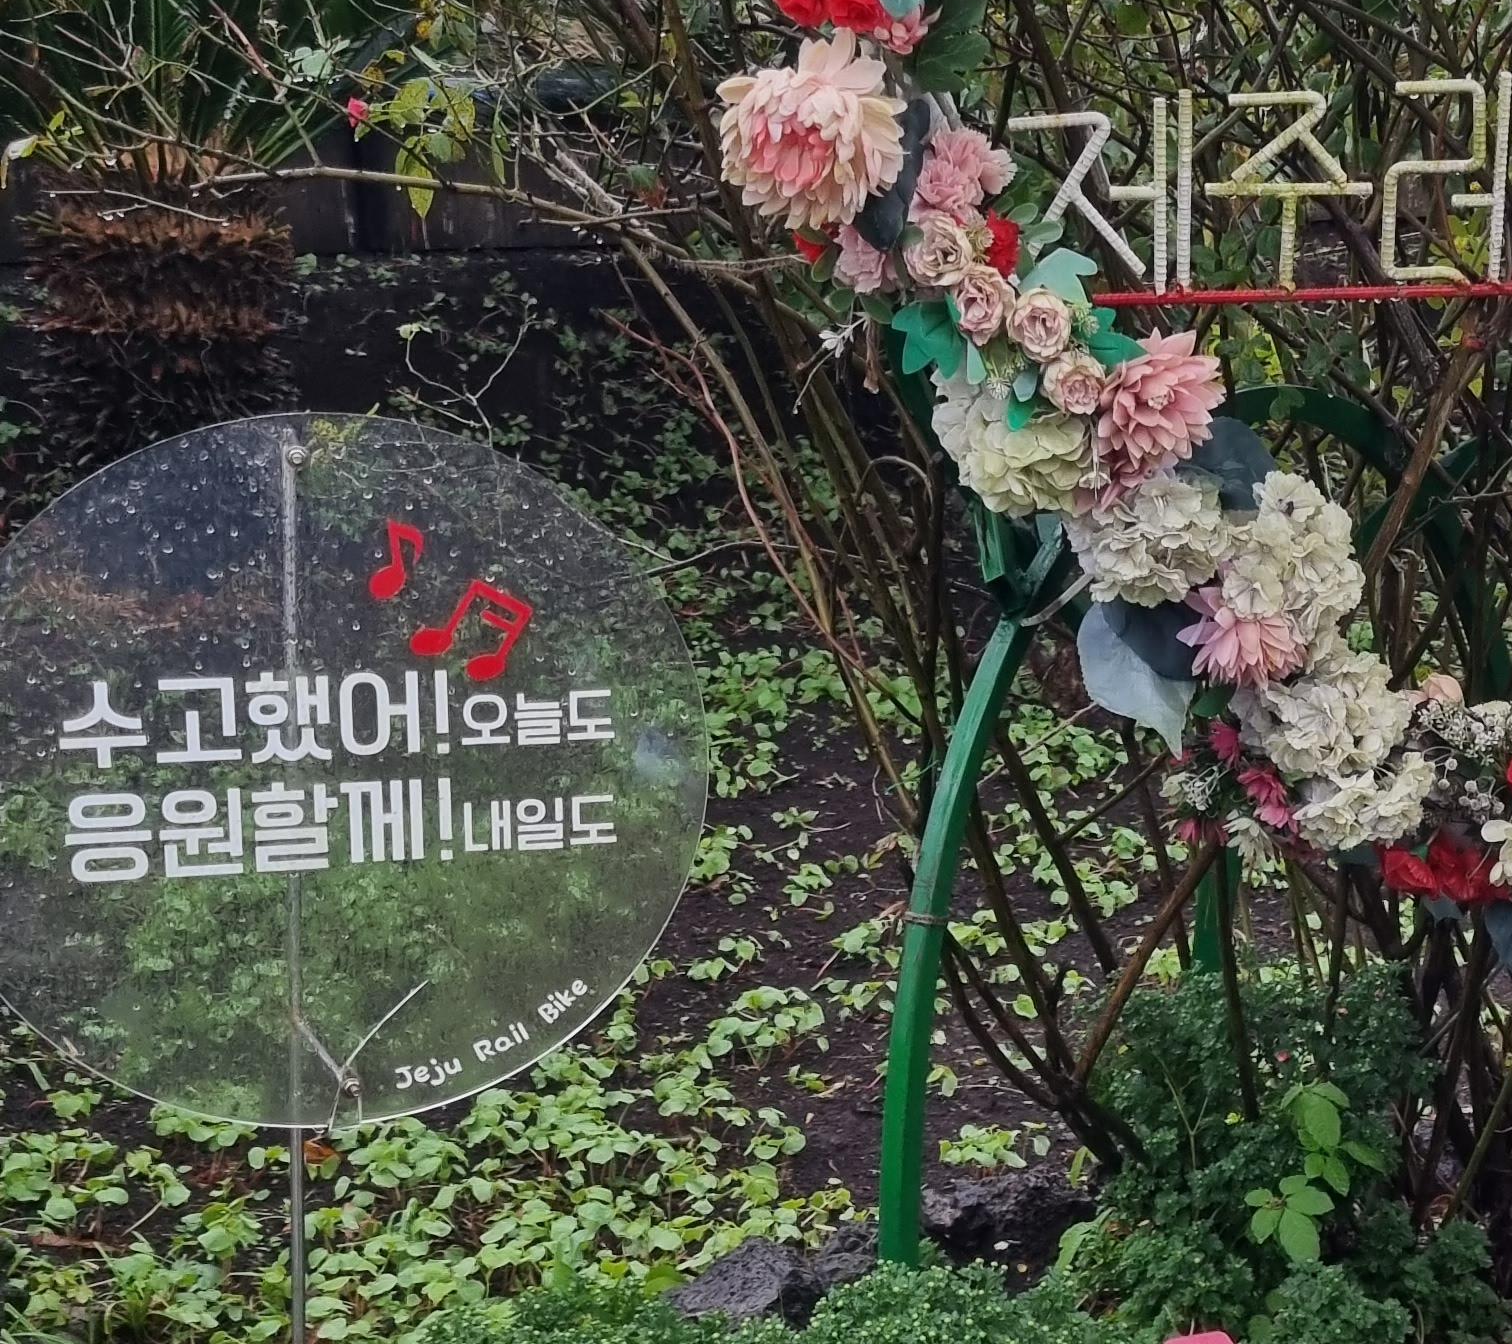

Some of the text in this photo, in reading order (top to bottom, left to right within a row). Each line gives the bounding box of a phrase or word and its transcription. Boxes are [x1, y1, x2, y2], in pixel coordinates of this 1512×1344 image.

[59, 668, 616, 769] 수고했어! 오늘도
[64, 777, 618, 883] 응원할께! 내일도
[395, 979, 588, 1089] Jeju Rail Bike
